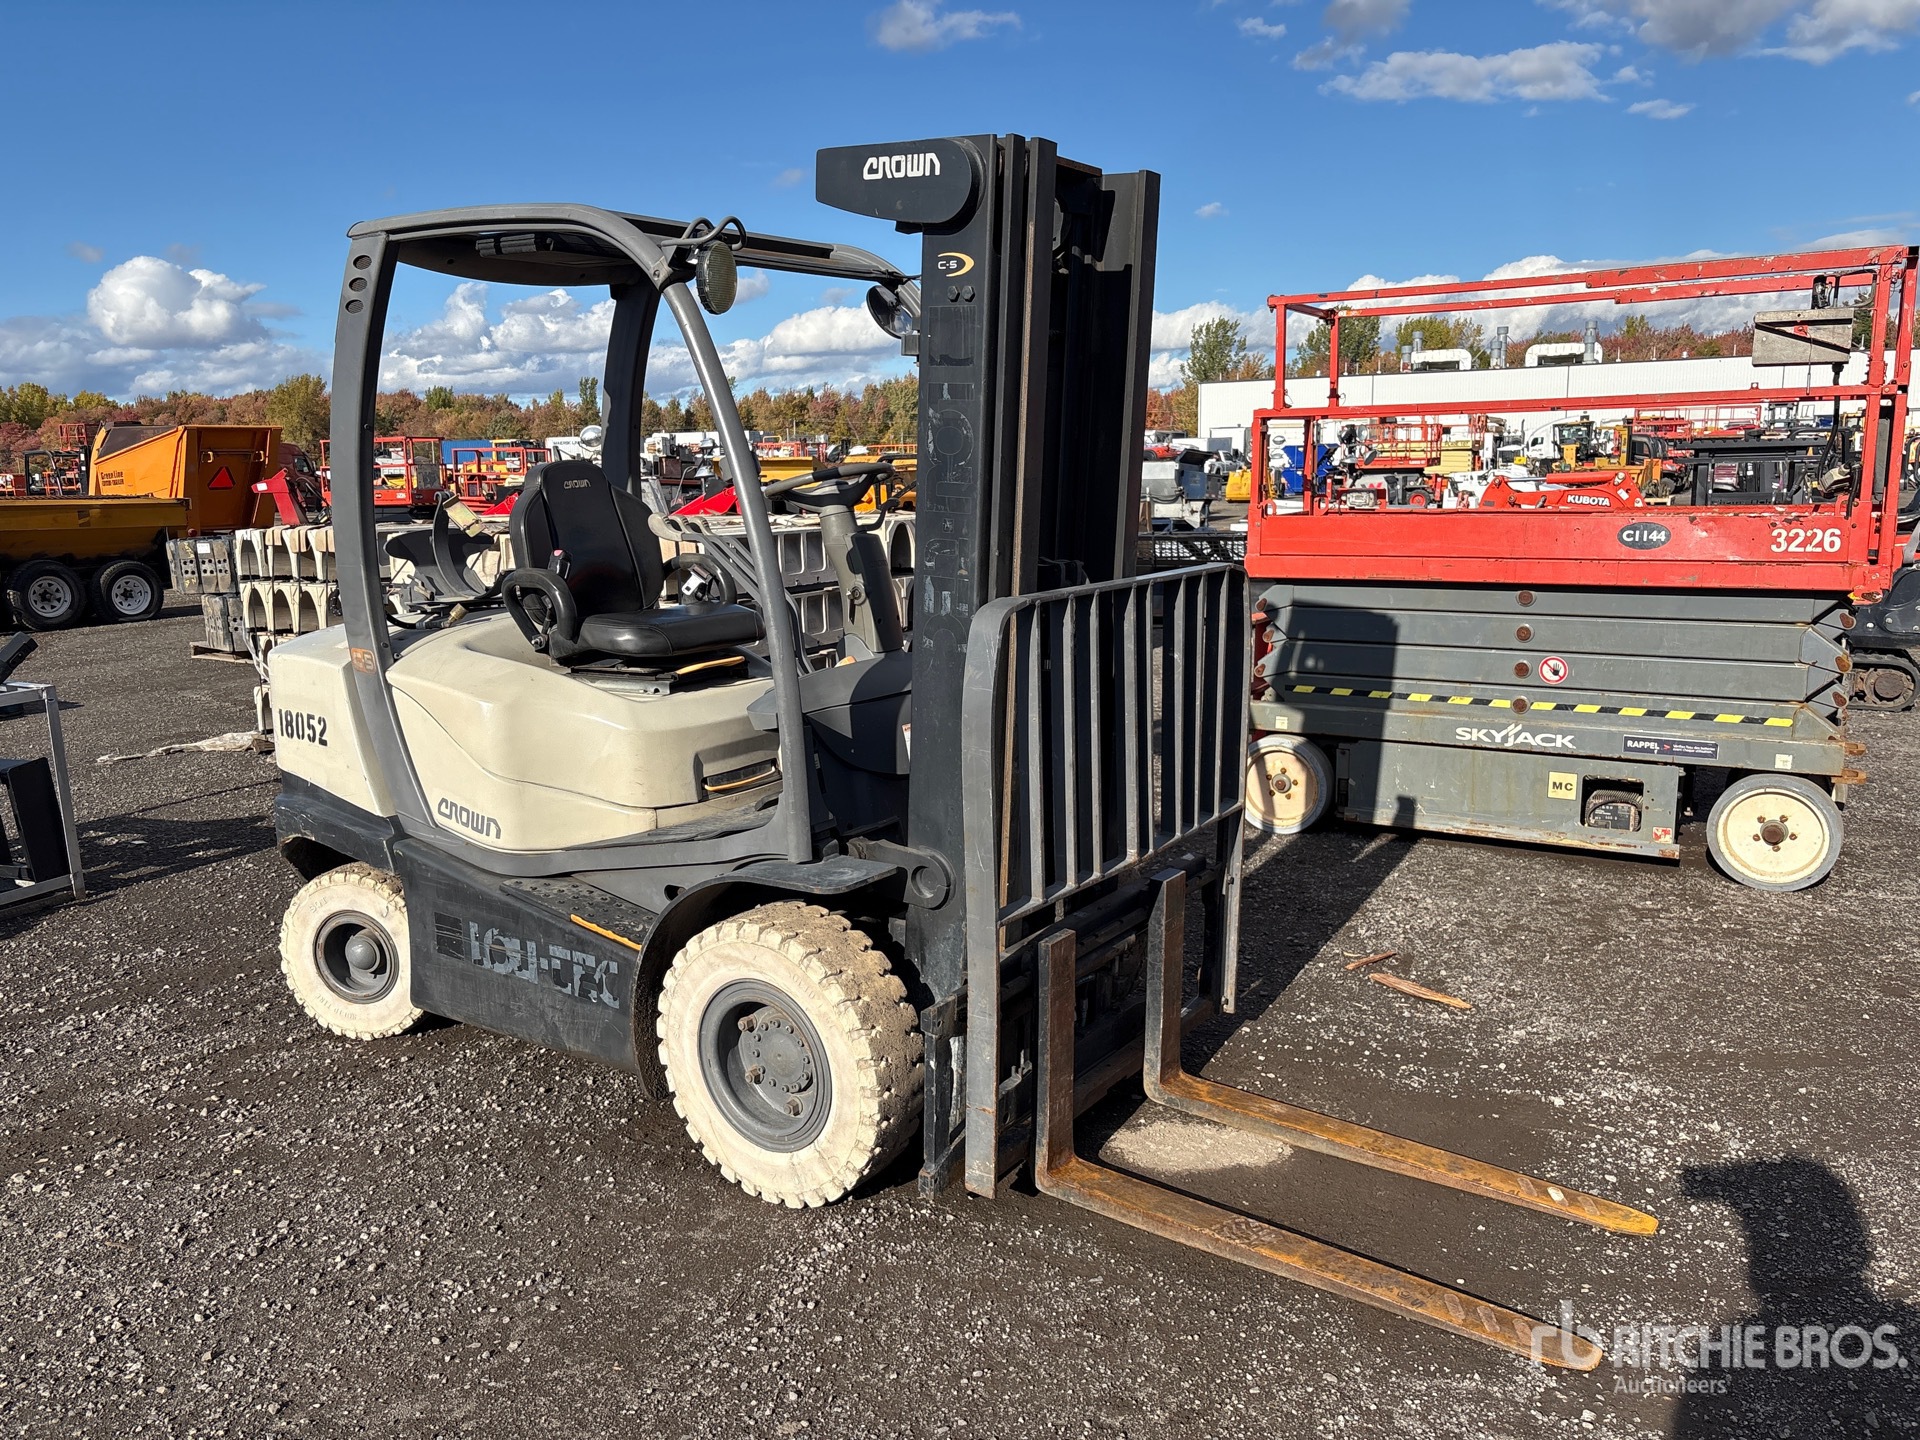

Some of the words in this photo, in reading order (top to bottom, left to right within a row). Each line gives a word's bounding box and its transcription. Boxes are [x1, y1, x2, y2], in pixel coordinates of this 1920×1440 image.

[863, 152, 941, 181] CROWN
[937, 260, 958, 270] C-5
[563, 479, 591, 490] CROWN
[1567, 494, 1611, 508] KUBOTA
[1770, 527, 1842, 553] 3226
[278, 708, 328, 747] 18052
[1455, 723, 1577, 749] SKYJACK
[1626, 740, 1660, 750] RAPPEL
[437, 797, 502, 840] CROWN
